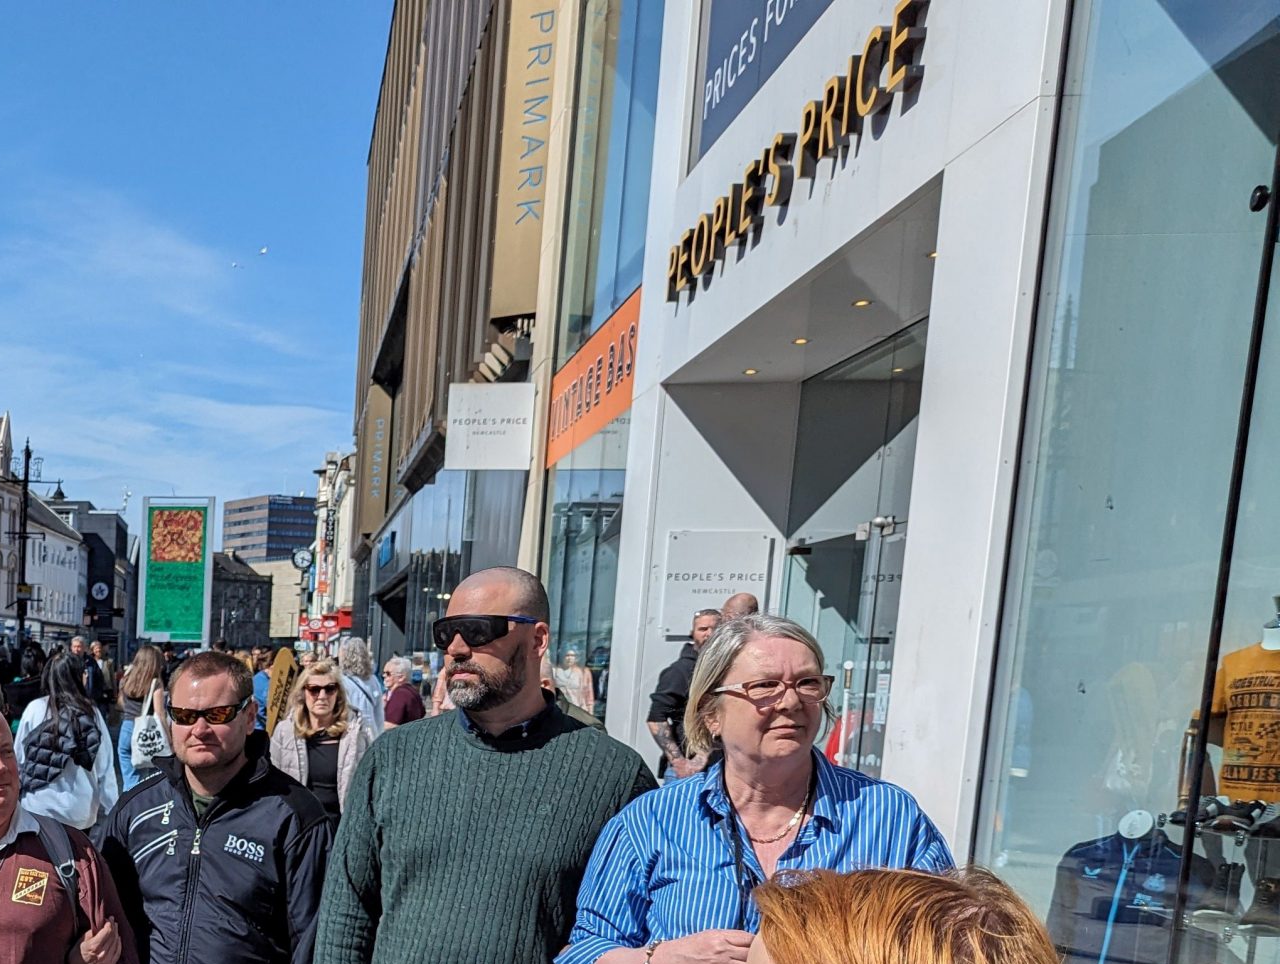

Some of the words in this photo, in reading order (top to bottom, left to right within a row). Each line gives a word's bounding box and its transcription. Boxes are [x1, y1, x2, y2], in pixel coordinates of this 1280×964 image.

[703, 17, 759, 120] PRICES
[763, 0, 799, 43] FO
[515, 10, 555, 225] PRIMARK
[666, 133, 793, 303] PEOPLE'S
[797, 0, 928, 180] PRICE
[550, 354, 603, 442] VINTAGE
[452, 418, 497, 426] PEOPLE'S
[501, 417, 528, 425] PRICE
[370, 419, 385, 498] PRIMARK
[666, 572, 725, 582] PEOPLE'S
[729, 572, 765, 582] PRICE
[137, 730, 162, 743] FOUR
[223, 846, 242, 855] HUGO
[224, 834, 265, 858] BOSS
[19, 875, 35, 883] EST.
